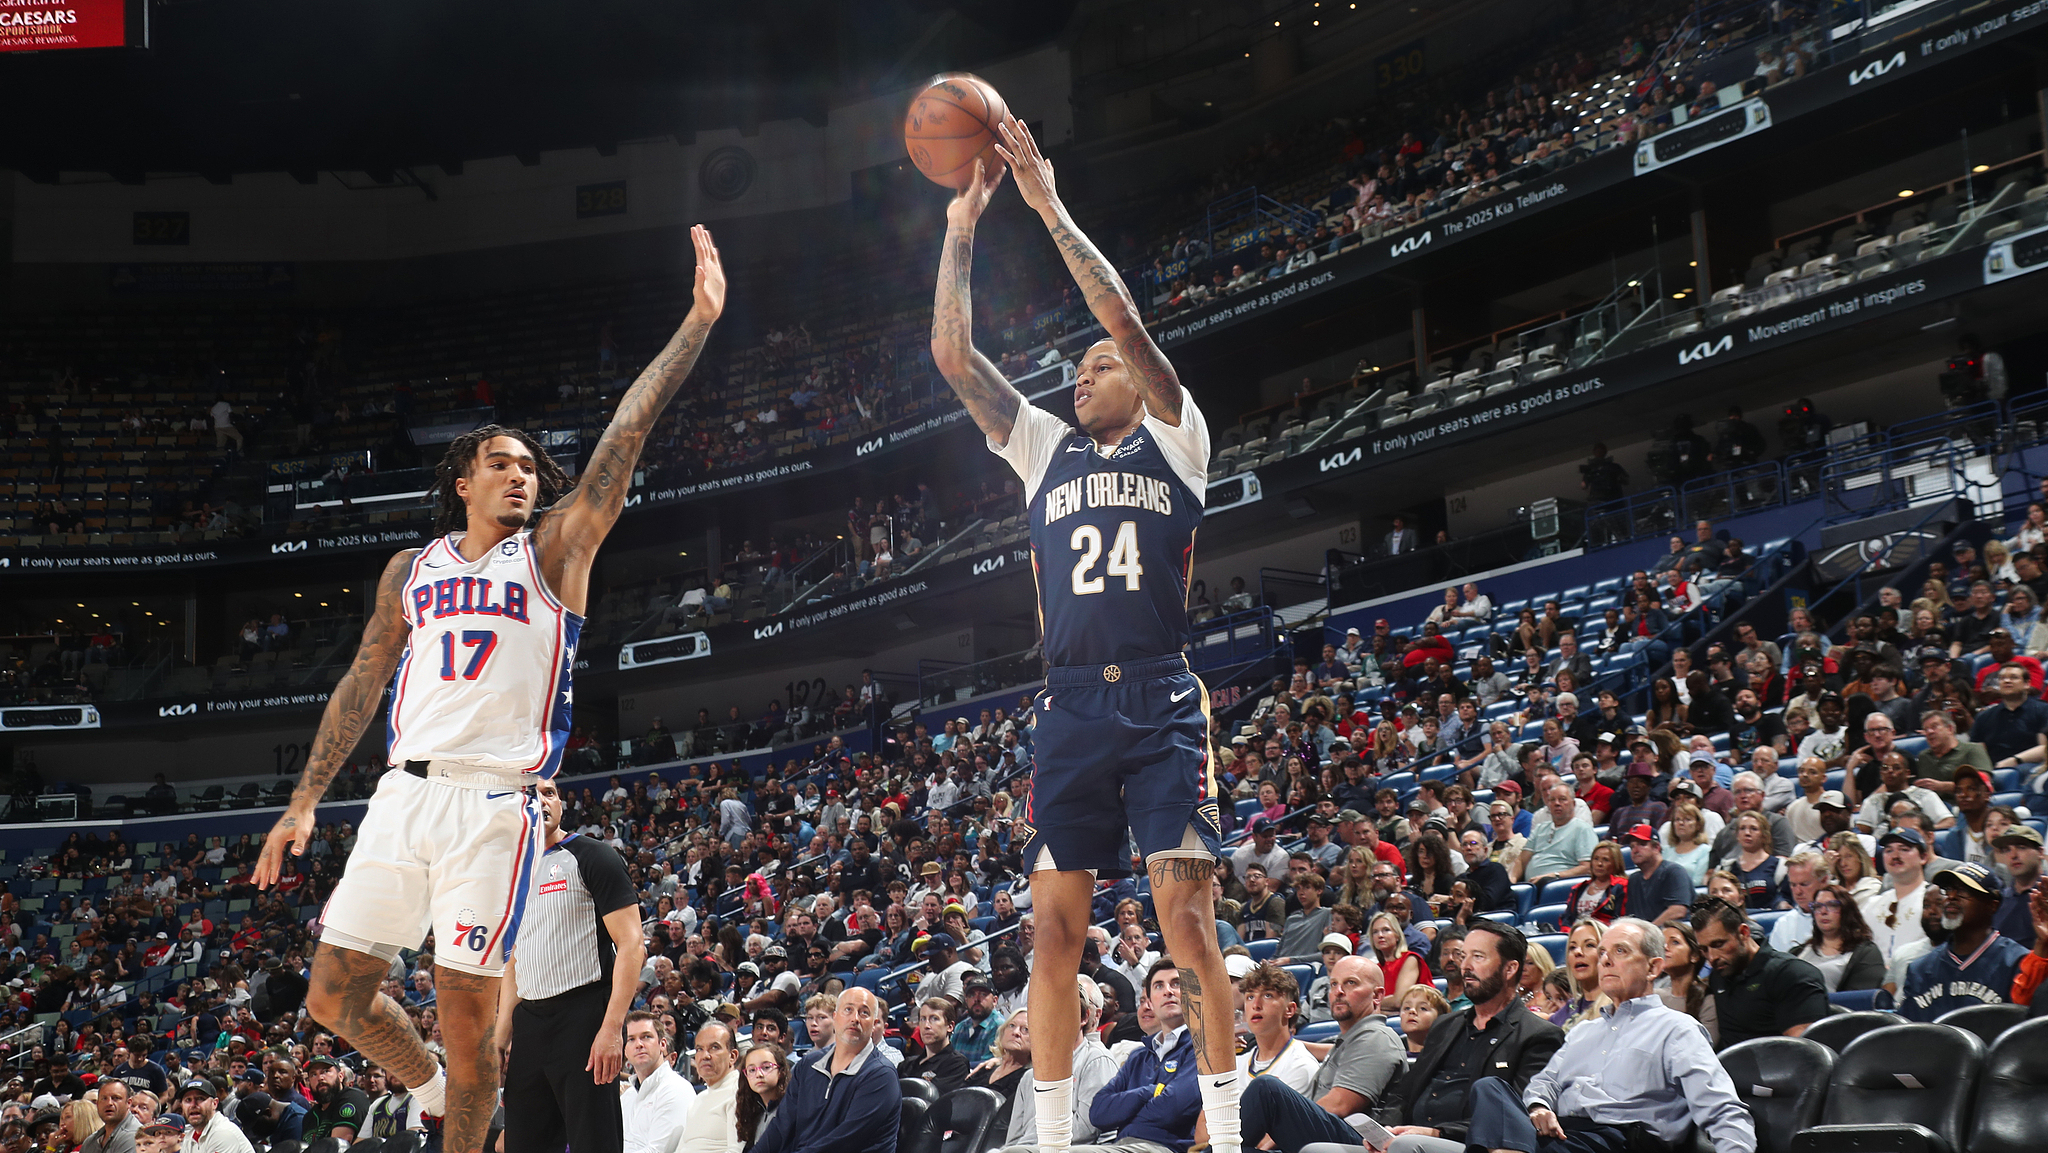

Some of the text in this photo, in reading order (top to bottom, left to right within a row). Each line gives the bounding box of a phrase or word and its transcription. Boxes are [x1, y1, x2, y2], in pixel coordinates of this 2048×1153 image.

[0, 9, 77, 27] CAESARS
[1921, 1, 2048, 57] If only your seat
[1, 37, 34, 46] AESARS
[1378, 49, 1424, 89] 330
[1443, 183, 1567, 237] The 2025 Kia Telluride.
[1157, 271, 1335, 343] If only your seats were as good as ours.
[1748, 280, 1925, 342] Movement that inspires
[890, 422, 925, 443] Movement
[927, 416, 941, 429] that
[1373, 378, 1604, 454] If only your seats were as good as ours.
[1112, 436, 1145, 459] NEWAGE
[649, 461, 812, 501] If only your seats were as good as ours.
[1044, 471, 1172, 526] NEW ORLEANS
[1449, 496, 1468, 514] 124
[317, 529, 422, 548] The 2025 Kia Telluride.
[1013, 550, 1029, 562] The
[20, 556, 28, 567] If
[31, 557, 54, 568] only
[57, 557, 80, 569] your
[83, 556, 110, 566] seats
[141, 556, 152, 564] as
[155, 553, 180, 565] good
[183, 554, 193, 562] as
[195, 552, 217, 560] ours.
[1070, 520, 1144, 596] 24
[412, 576, 530, 629] PHILA
[788, 581, 928, 629] If only your seats were as good as ours.
[440, 630, 498, 681] 17
[207, 693, 328, 711] If only your seats were as
[540, 882, 567, 894] Emirates
[452, 920, 489, 952] 76
[1913, 983, 1943, 1009] NEW
